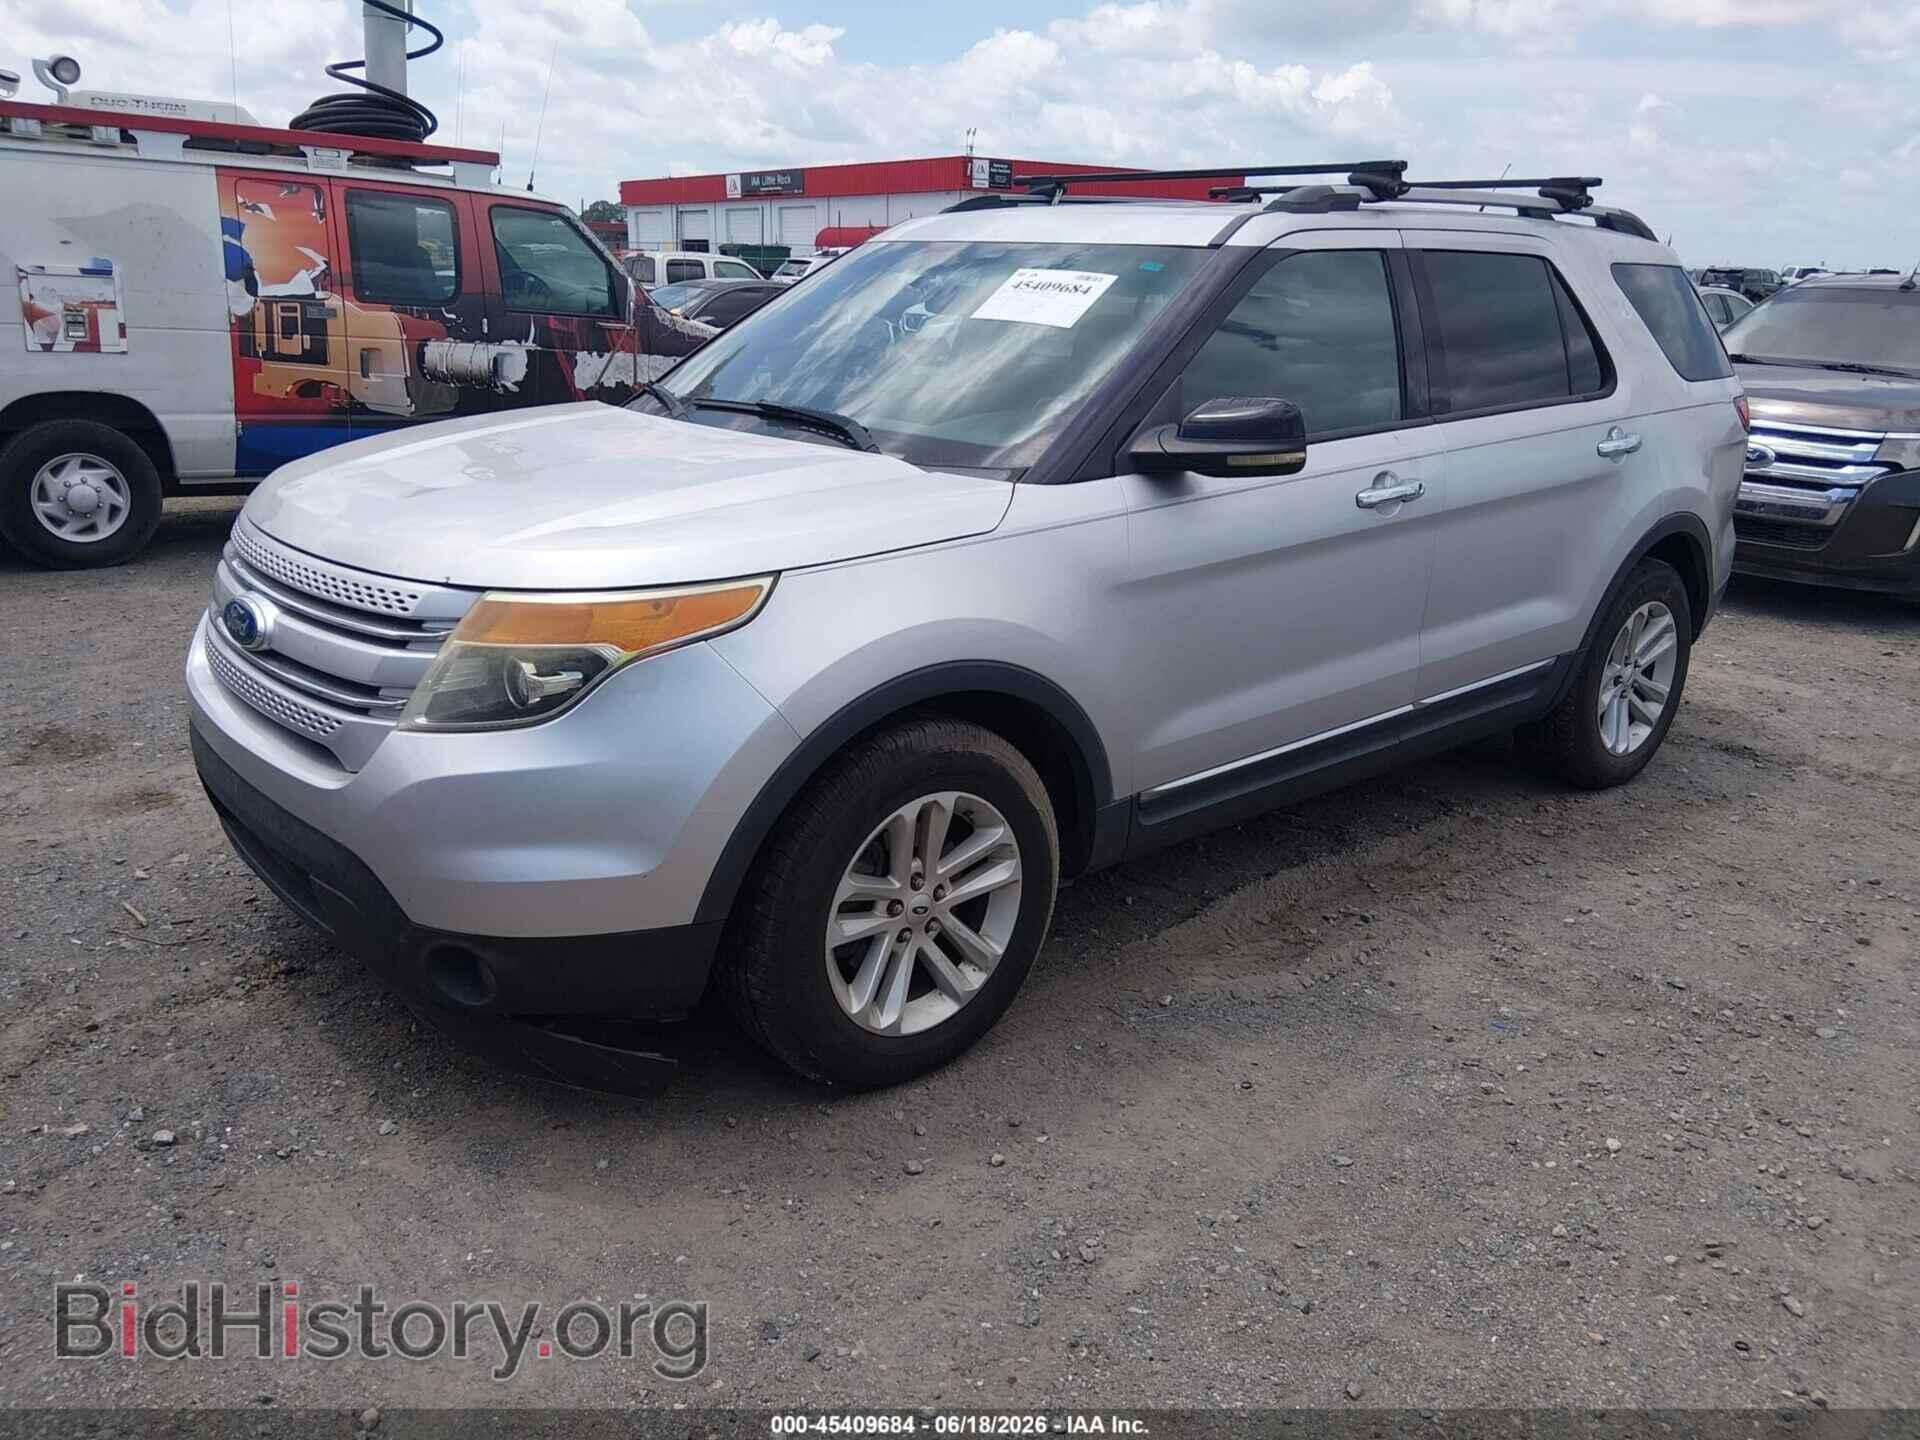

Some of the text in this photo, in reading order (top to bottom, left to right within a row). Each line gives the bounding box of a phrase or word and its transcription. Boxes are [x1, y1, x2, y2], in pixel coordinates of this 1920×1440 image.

[761, 174, 776, 186] Little
[777, 173, 791, 185] Rock
[1011, 280, 1093, 295] 45409684
